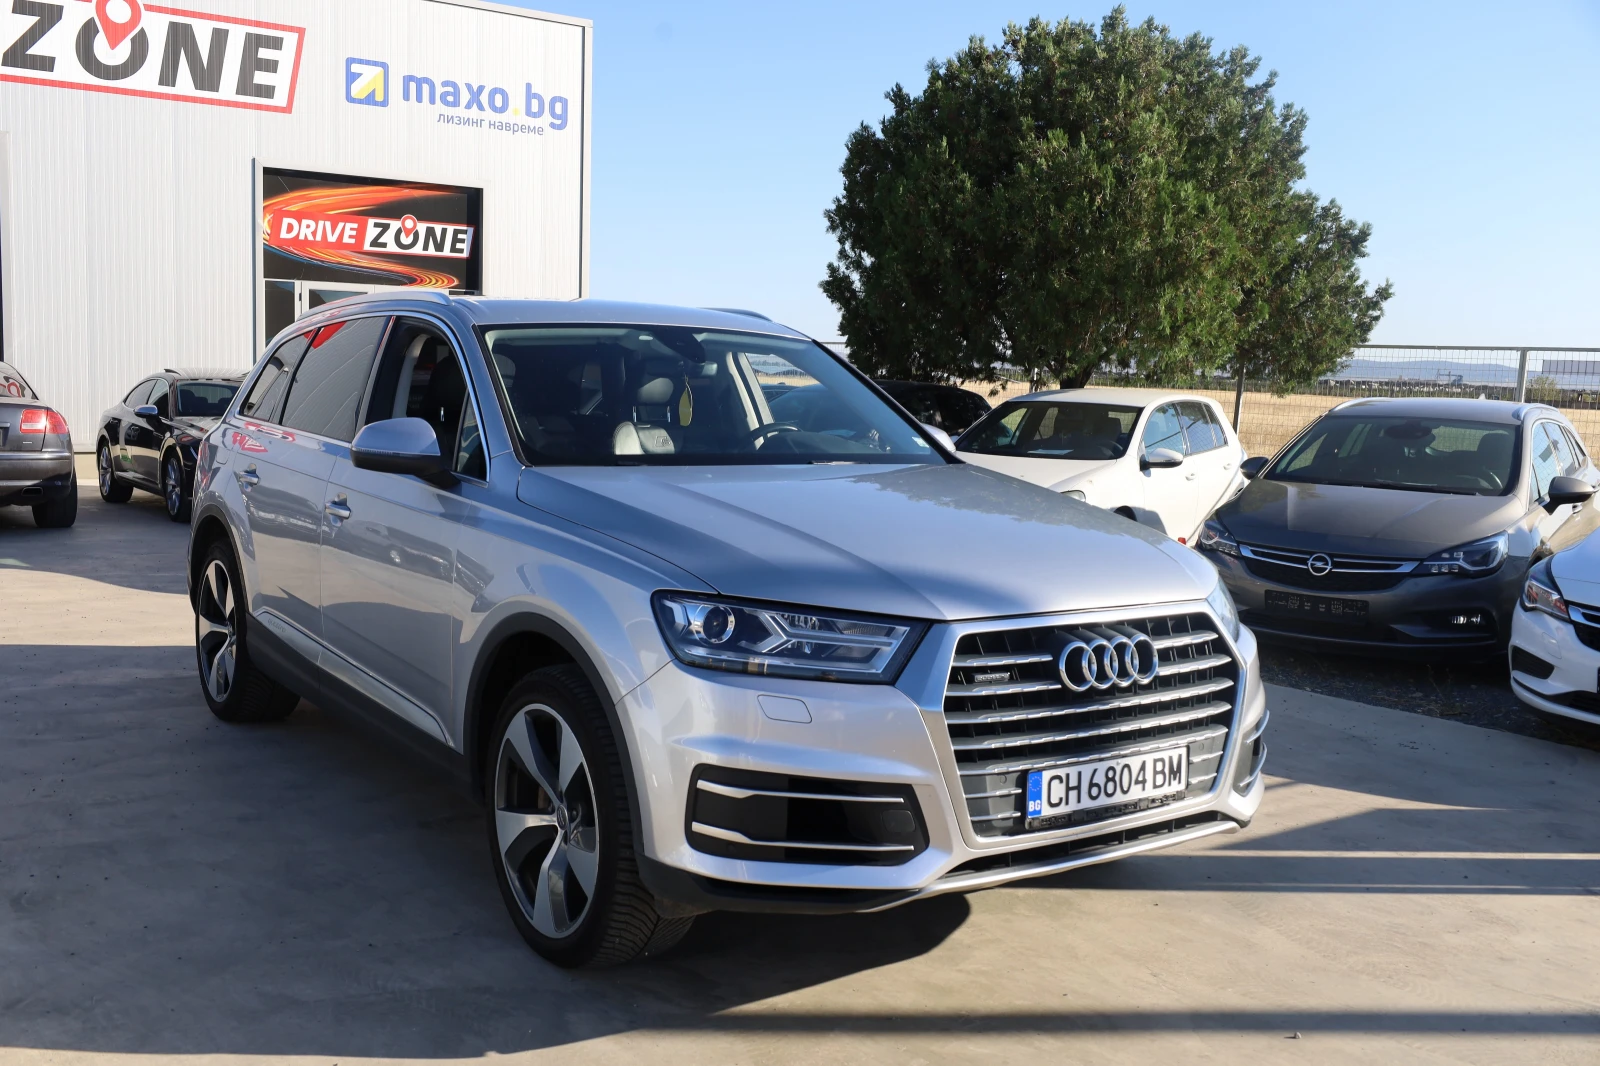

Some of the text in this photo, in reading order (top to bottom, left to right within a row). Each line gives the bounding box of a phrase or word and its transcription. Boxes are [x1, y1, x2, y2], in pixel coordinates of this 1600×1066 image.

[1, 0, 285, 100] ZONE
[402, 74, 569, 131] maxo.bg
[437, 113, 545, 136] лизинг навреме
[279, 217, 468, 254] DRIVE ZONE
[1028, 800, 1041, 812] BG
